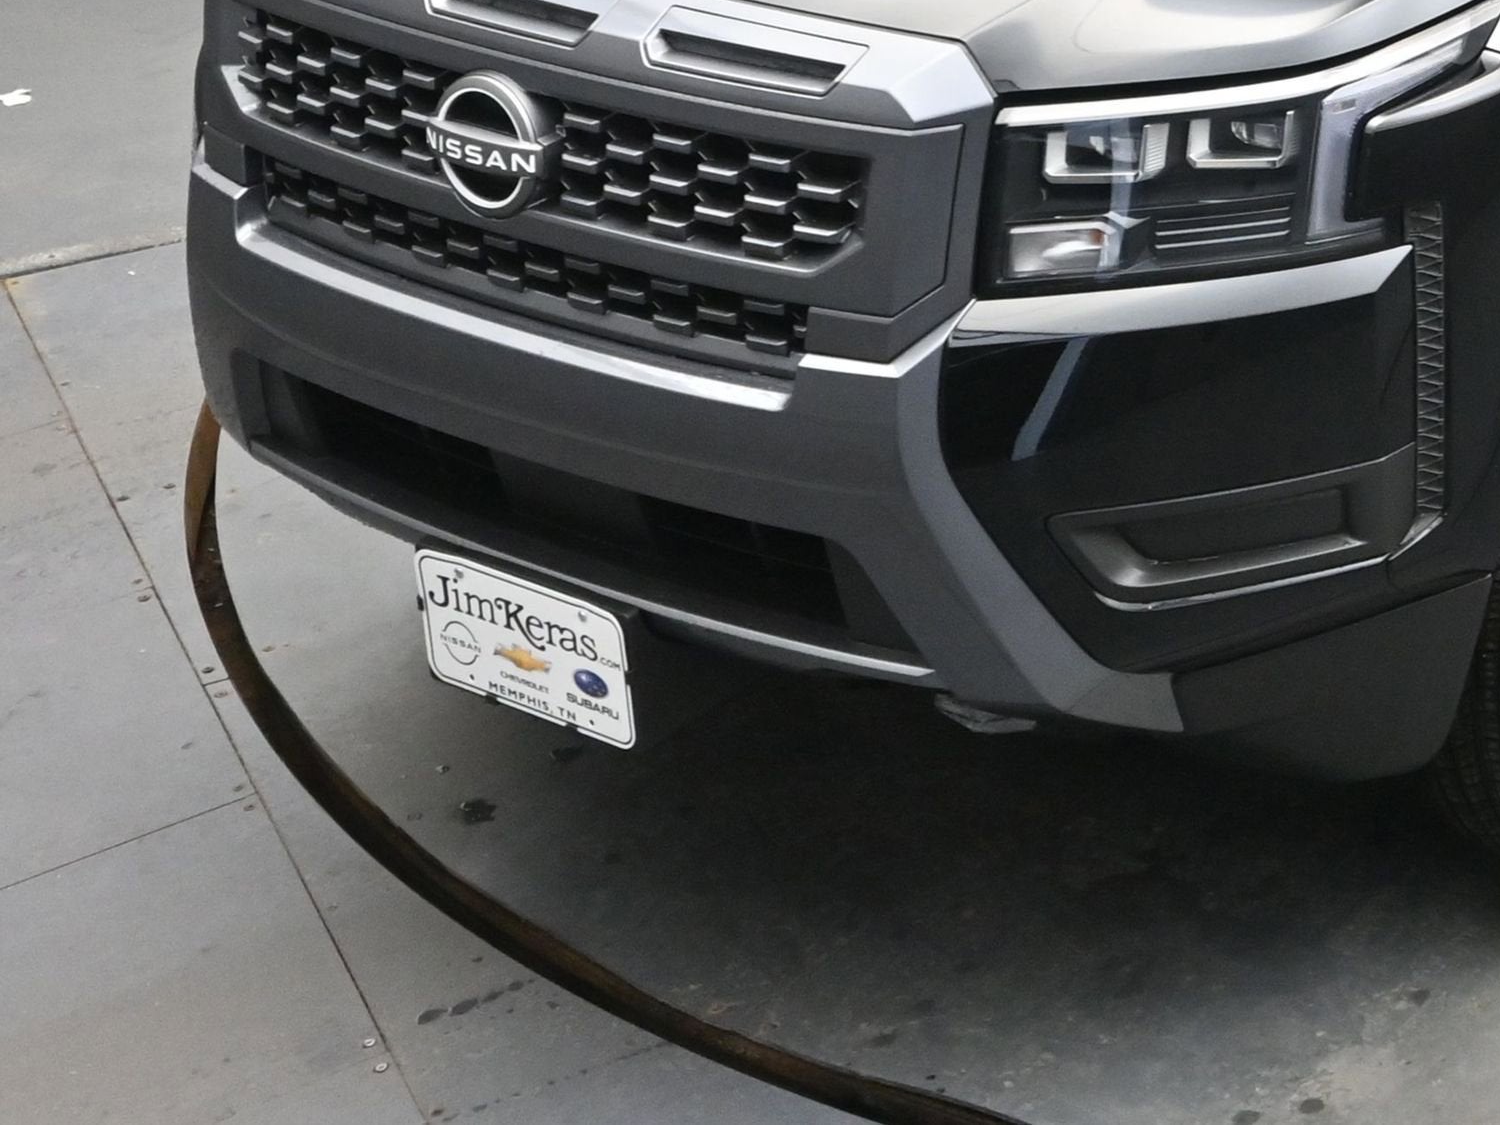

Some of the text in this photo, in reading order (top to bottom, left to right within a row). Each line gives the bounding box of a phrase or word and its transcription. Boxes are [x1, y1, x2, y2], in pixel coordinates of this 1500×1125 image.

[426, 126, 536, 173] NISSAN
[440, 633, 481, 654] NISSAN
[500, 670, 550, 694] CHEVROLET
[489, 681, 577, 721] MEMPHIS, TN
[566, 692, 619, 720] SUBARU
